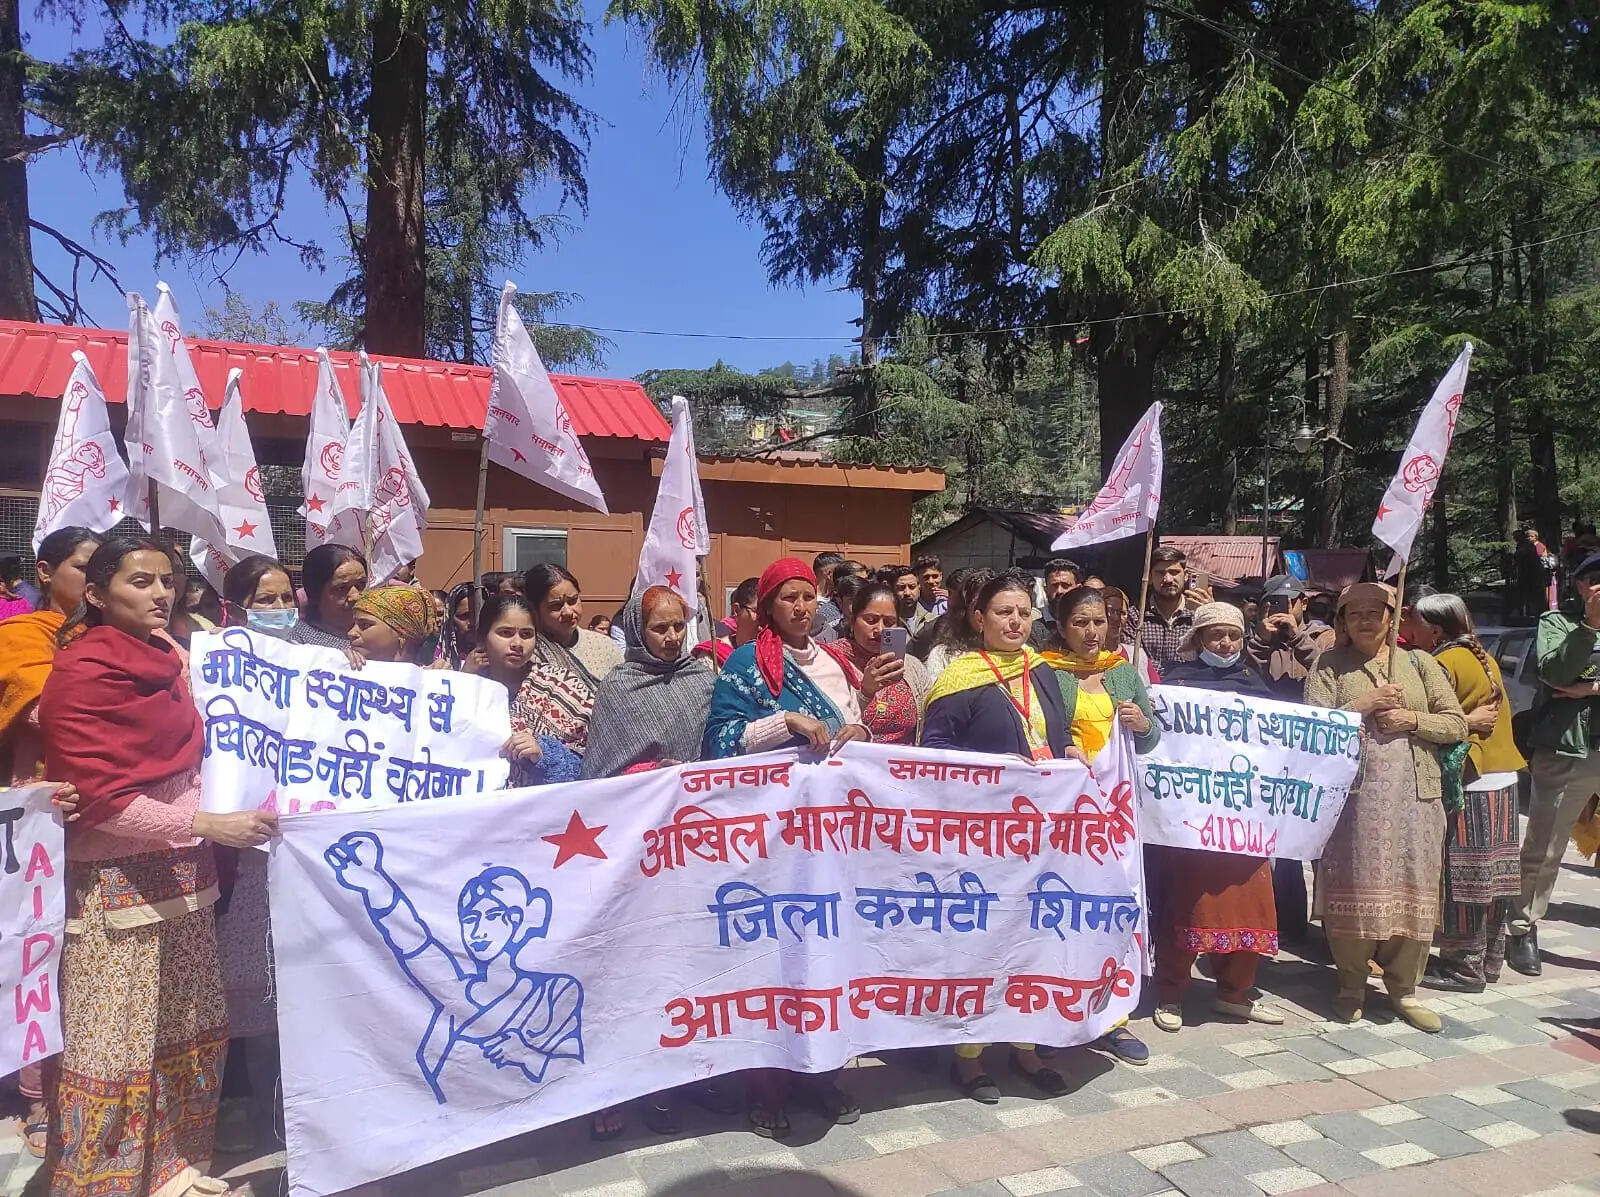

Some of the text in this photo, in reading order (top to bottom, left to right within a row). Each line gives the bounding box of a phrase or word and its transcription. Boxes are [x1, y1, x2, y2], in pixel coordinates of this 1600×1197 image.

[202, 629, 299, 709] महिला
[427, 679, 456, 734] से
[1217, 699, 1253, 744] को
[316, 728, 386, 800] नहीं
[680, 761, 794, 793] जनवाद
[887, 759, 1006, 786] समानता
[1144, 763, 1213, 805] करना
[639, 804, 771, 878] अखिल
[776, 788, 906, 855] भारतीय
[907, 795, 1046, 863] जनवादी
[706, 881, 842, 948] जिला
[854, 871, 1001, 933] कमेटी
[659, 986, 843, 1049] आपका
[848, 976, 994, 1020] स्वागत
